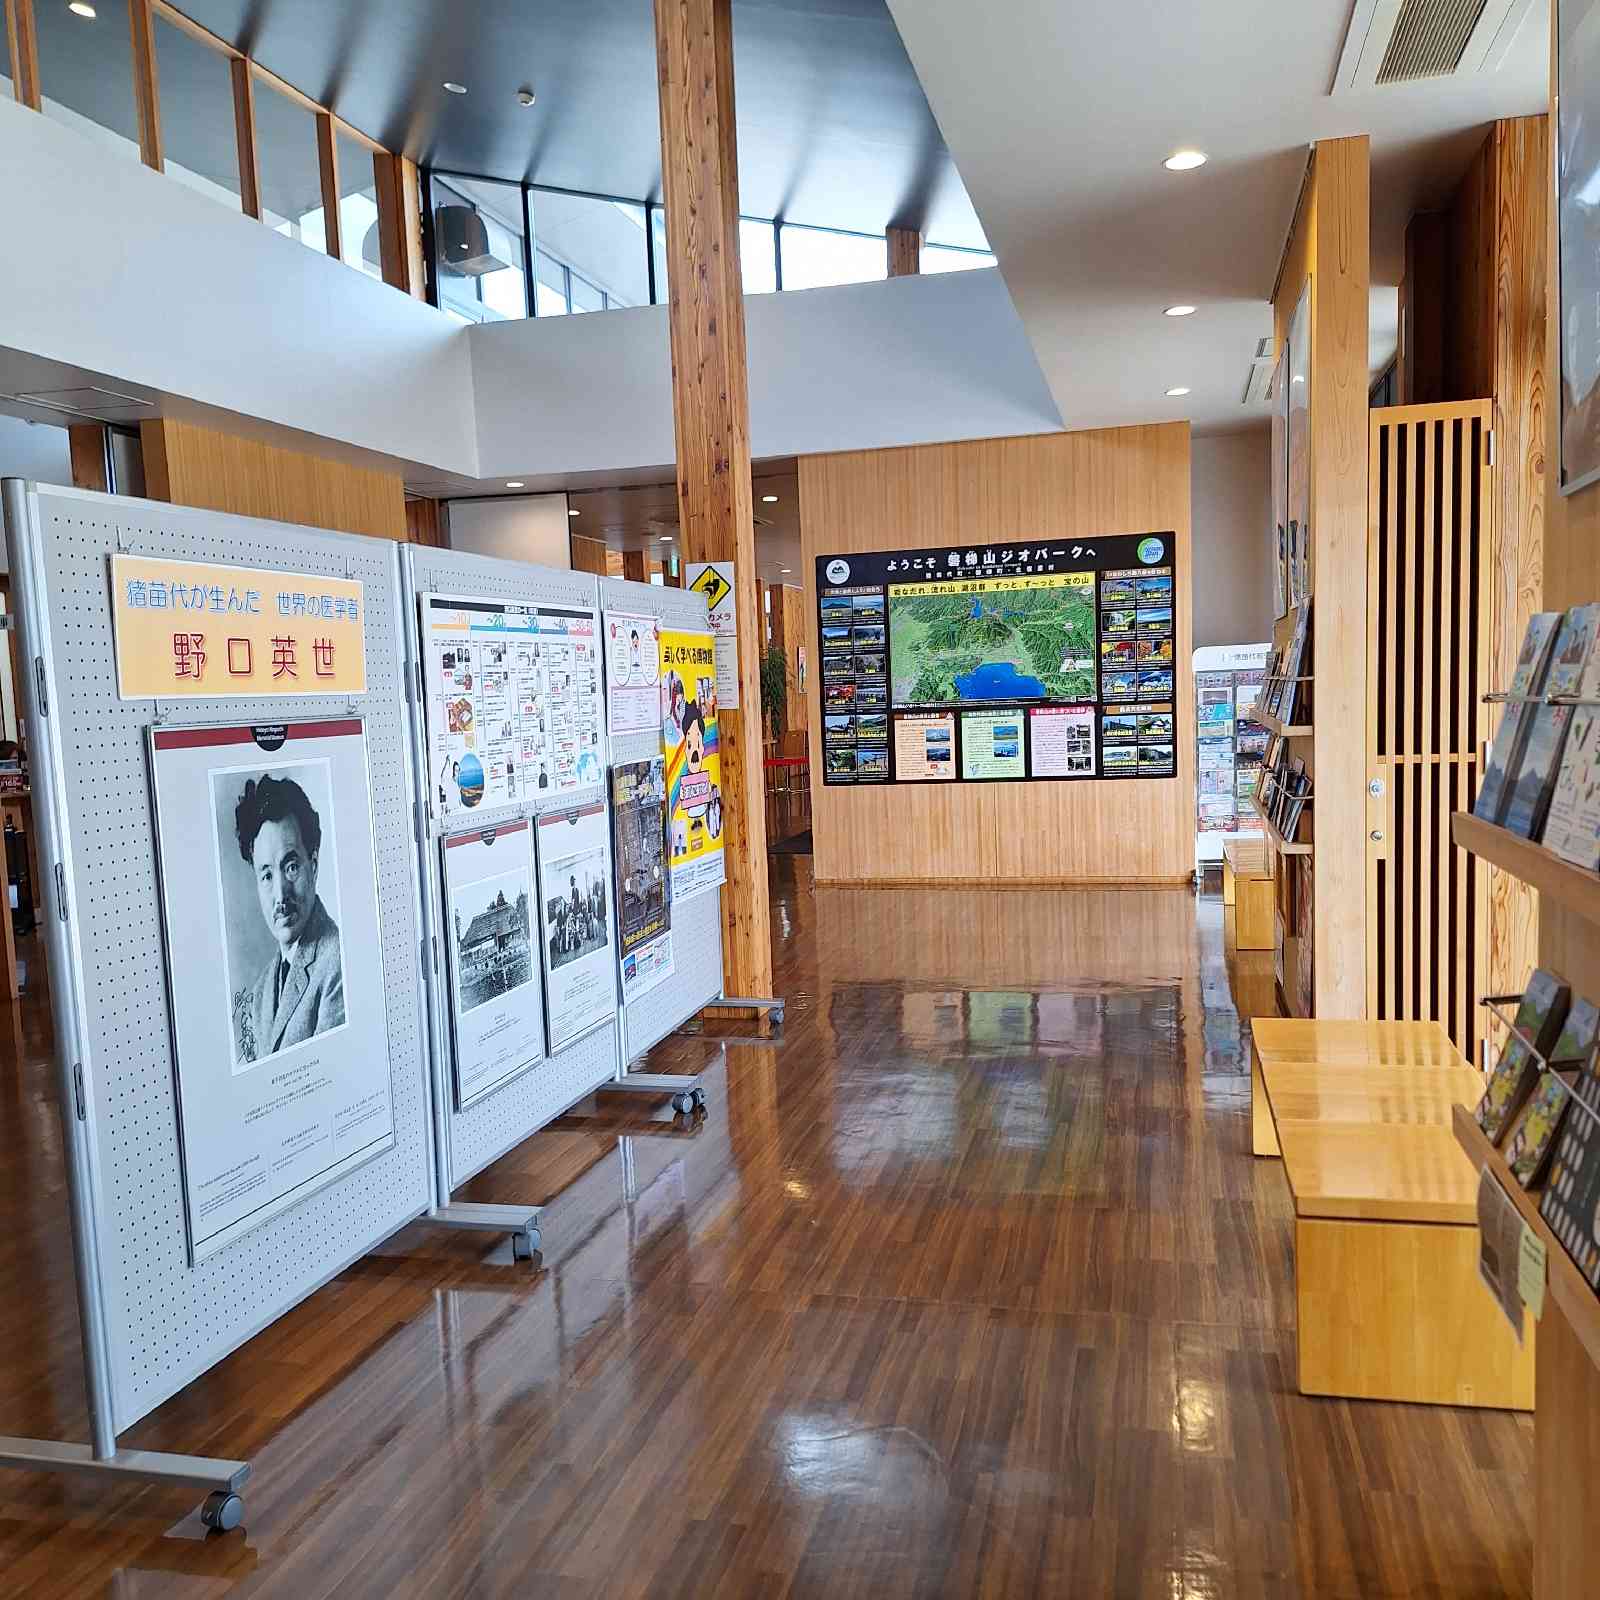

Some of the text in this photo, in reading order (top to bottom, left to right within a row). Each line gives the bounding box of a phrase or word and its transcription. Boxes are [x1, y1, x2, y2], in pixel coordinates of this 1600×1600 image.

[887, 557, 936, 571] ようこそ
[1063, 576, 1089, 586] 宝の山
[126, 579, 359, 620] 猪苗代が生んだ 世界の医学者
[173, 632, 337, 680] 野口英世
